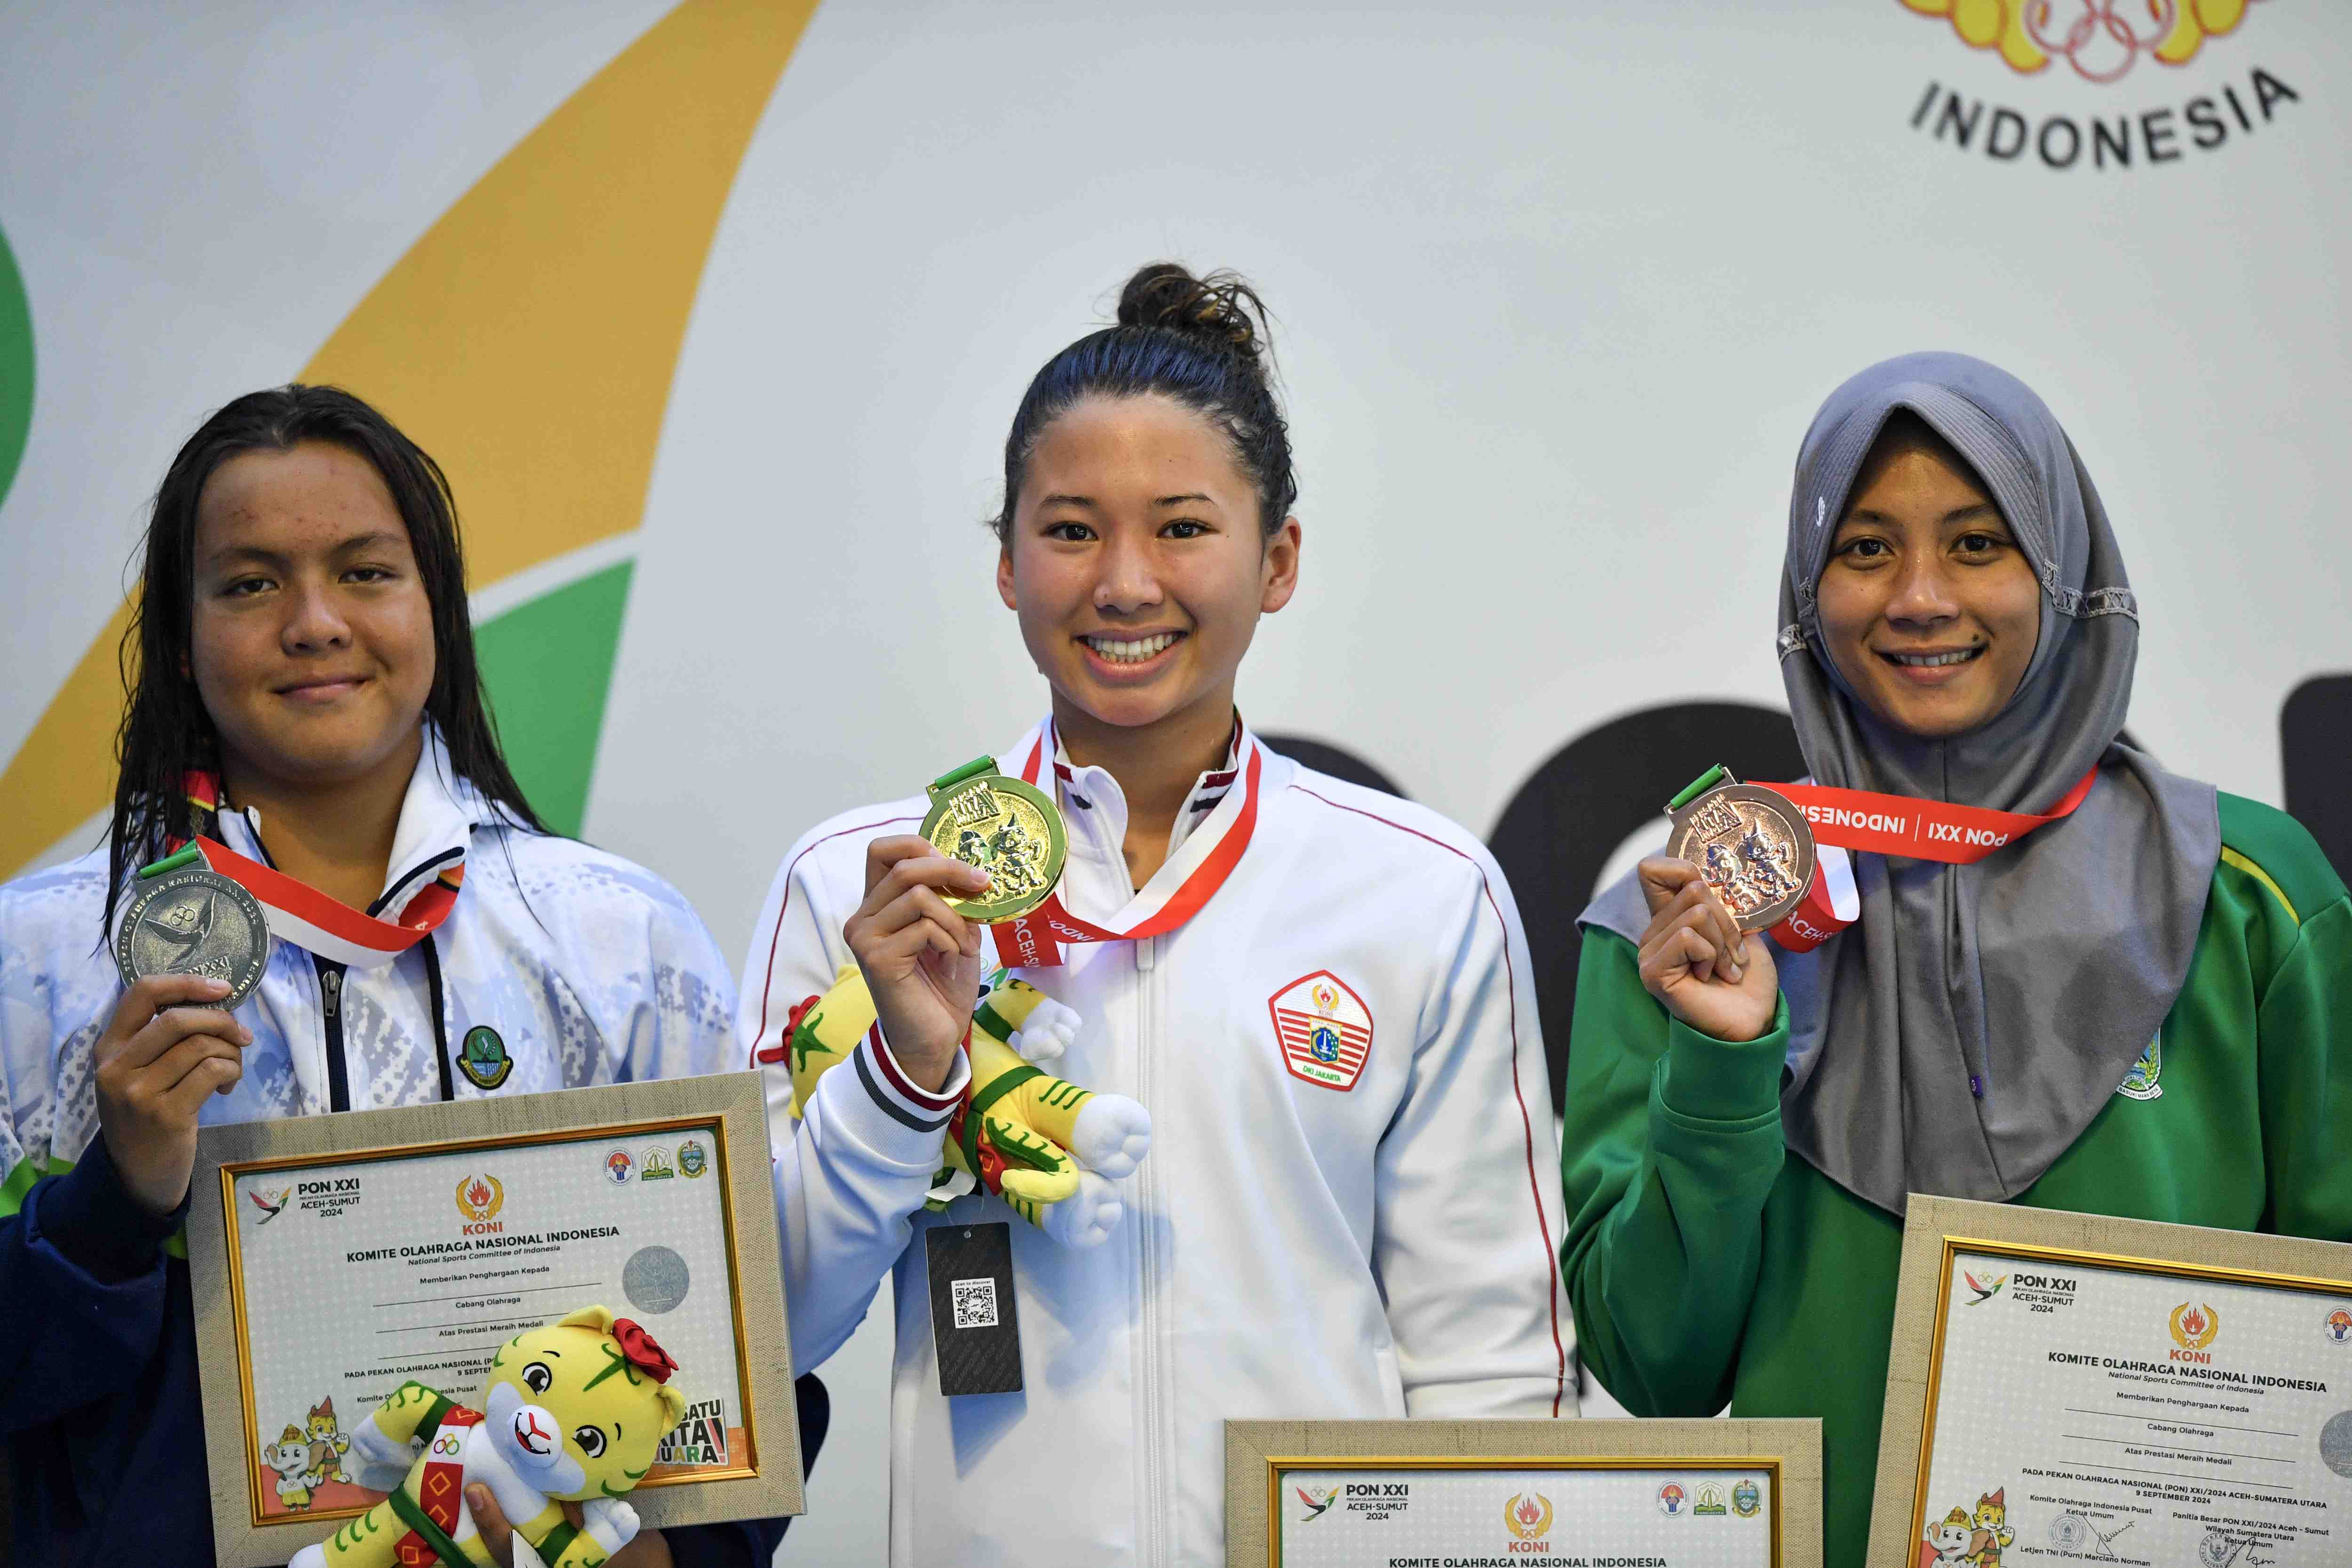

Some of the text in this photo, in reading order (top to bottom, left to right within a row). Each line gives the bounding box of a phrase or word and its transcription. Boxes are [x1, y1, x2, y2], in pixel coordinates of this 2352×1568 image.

[1910, 67, 2299, 169] INDONESIA
[1796, 804, 2008, 847] PON XXI INDONESI
[1303, 1065, 1341, 1082] DKI JAKARTA
[298, 1178, 359, 1195] PON XXI
[301, 1196, 360, 1210] ACEH-SUMUT
[320, 1208, 342, 1217] 2024
[462, 1221, 502, 1235] KONI
[347, 1226, 620, 1262] KOMITE OLAHRAGA NASIONAL INDONESIA
[408, 1256, 440, 1266] National
[442, 1255, 466, 1263] Sports
[469, 1250, 512, 1259] Committee
[524, 1245, 560, 1254] Indonesia
[420, 1266, 549, 1284] Memberikan Penghargaan Kepada
[2013, 1274, 2076, 1291] PON XXI
[2012, 1292, 2074, 1306] ACEH-SUMUT
[2030, 1304, 2053, 1313] 2024
[458, 1326, 487, 1335] Prestasi
[490, 1323, 516, 1331] Meraih
[518, 1320, 543, 1329] Medali
[2169, 1349, 2210, 1364] KONI
[368, 1368, 394, 1376] PEKAN
[396, 1363, 439, 1373] OLAHRAGA
[442, 1359, 482, 1369] NASIONAL
[2049, 1352, 2327, 1393] KOMITE OLAHRAGA NASIONAL INDONESIA
[2108, 1371, 2141, 1380] National
[2143, 1375, 2168, 1384] Sports
[2170, 1378, 2214, 1389] Committee
[2226, 1385, 2264, 1394] Indonesia
[2116, 1392, 2249, 1413] Memberikan Penghargaan Kepada
[2147, 1423, 2214, 1437] Cabang Olahraga
[2144, 1449, 2175, 1458] Prestasi
[2177, 1453, 2203, 1462] Meraih
[2206, 1457, 2232, 1465] Medali
[1346, 1484, 1408, 1496] PON XXI
[2046, 1471, 2073, 1479] PEKAN
[2075, 1474, 2119, 1485] OLAHRAGA
[2122, 1479, 2162, 1489] NASIONAL
[2165, 1484, 2188, 1493] (PON)
[2190, 1487, 2226, 1497] XXI/2024
[2228, 1492, 2298, 1505] ACEH-SUMATERA
[2300, 1500, 2327, 1509] UTARA
[2143, 1490, 2190, 1502] SEPTEMBER
[2058, 1498, 2091, 1508] Olahraga
[2093, 1502, 2130, 1512] Indonesia
[2090, 1511, 2114, 1519] Umum
[2172, 1512, 2198, 1520] Panitia
[2241, 1520, 2276, 1529] XXI/2024
[2304, 1527, 2329, 1536] Sumut
[2205, 1525, 2234, 1536] Wilayah
[2236, 1528, 2272, 1538] Sumatera
[1509, 1541, 1549, 1552] KONI
[2225, 1536, 2273, 1548] Ketua Umum
[1390, 1558, 1667, 1568] KOMITE OLAHRAGA NASIONAL INDONESIA
[2020, 1546, 2043, 1554] Letjen
[2060, 1550, 2082, 1560] (Purn)
[2084, 1553, 2119, 1563] Marciano
[2121, 1558, 2150, 1567] Norman
